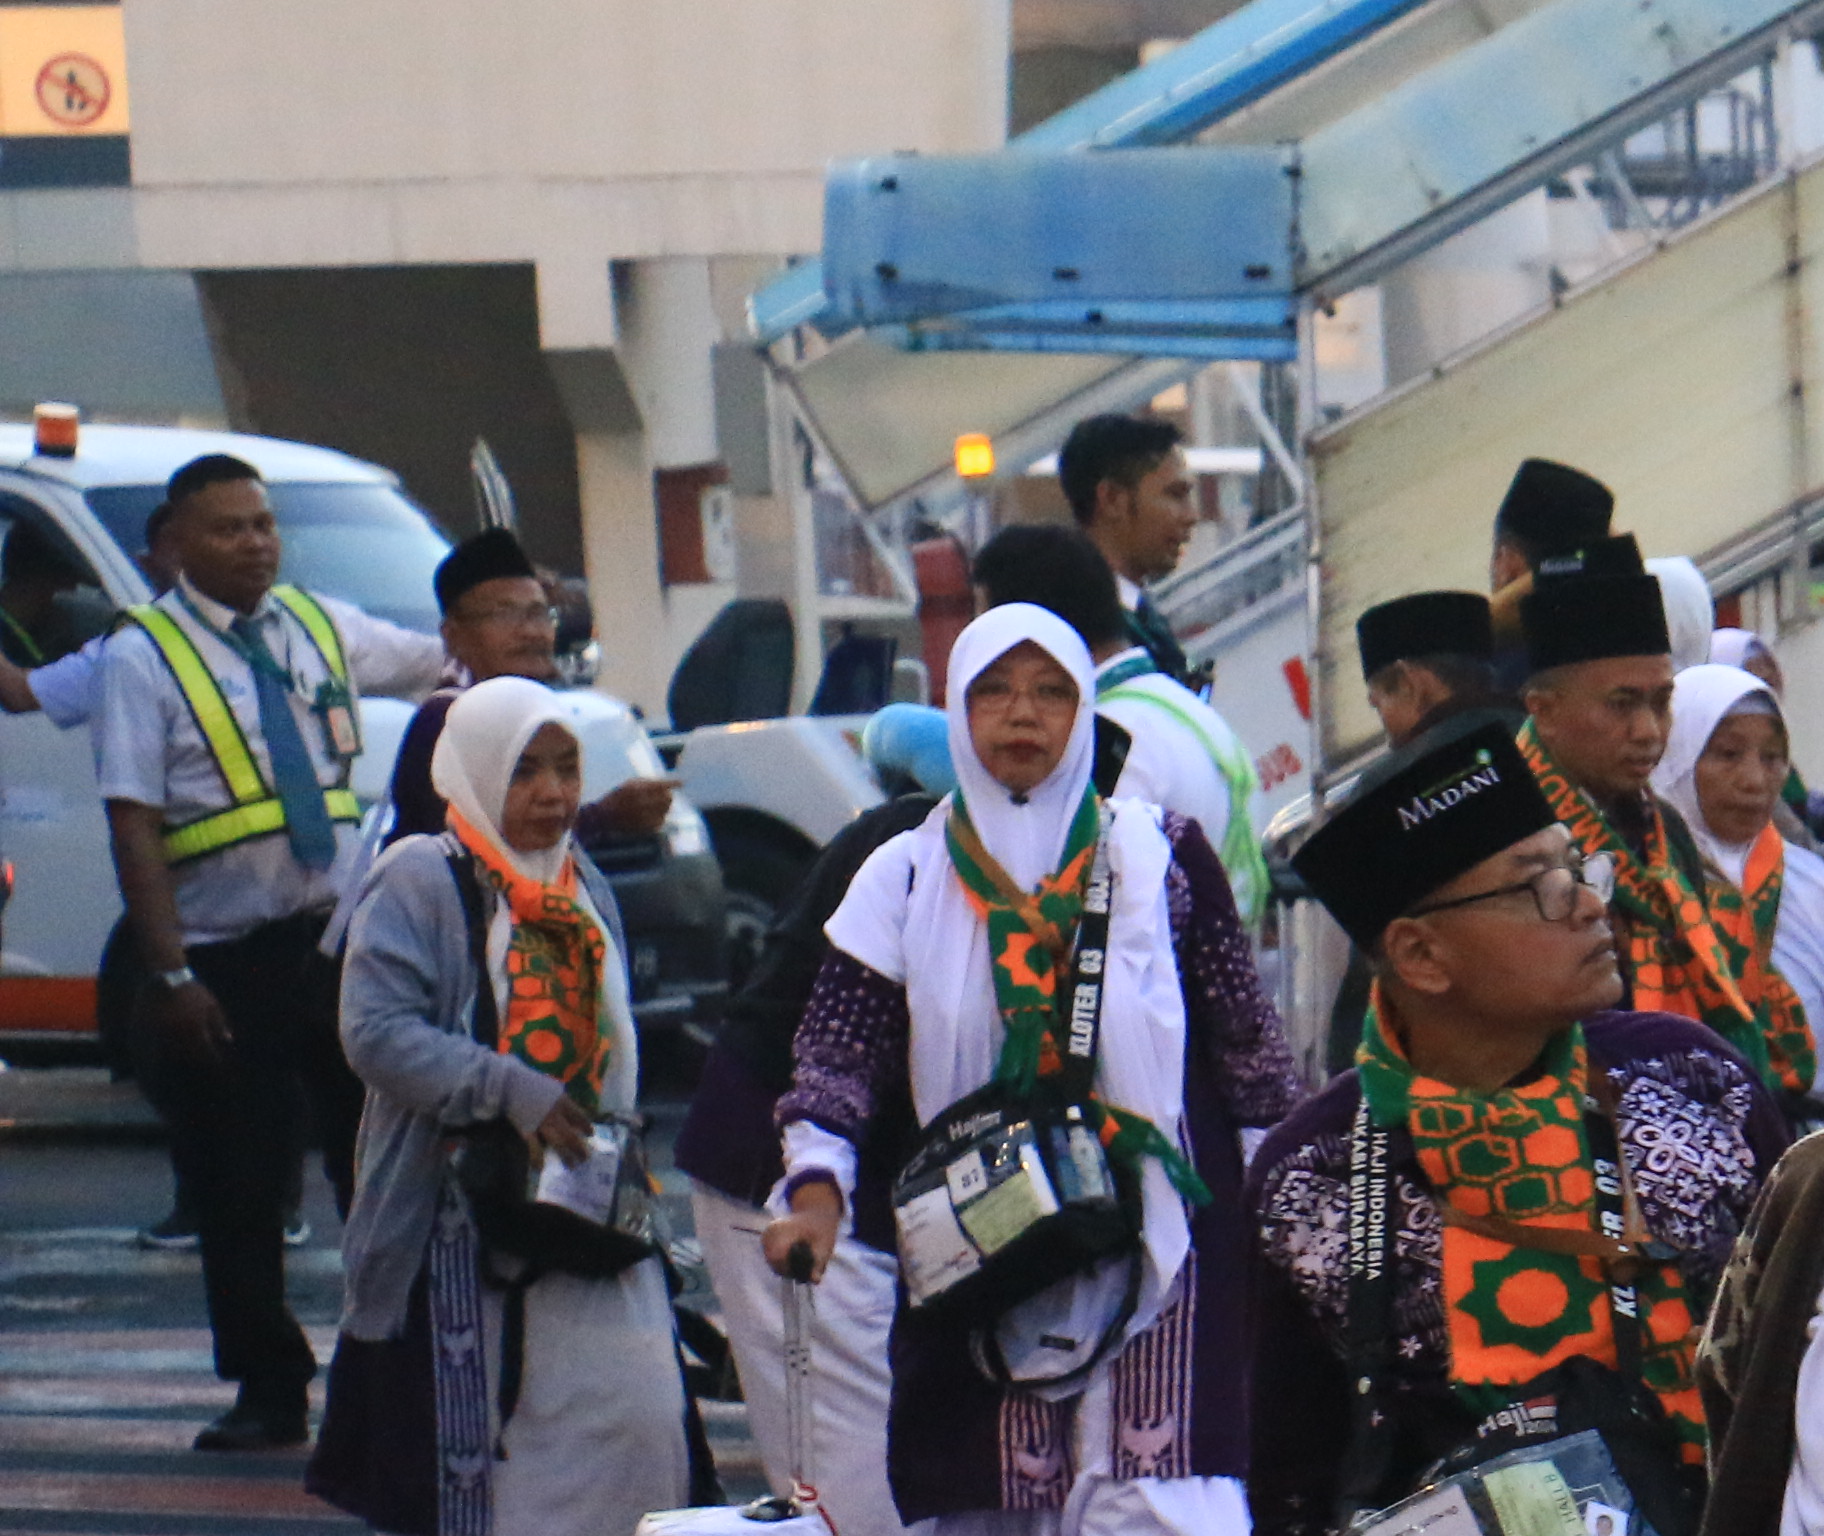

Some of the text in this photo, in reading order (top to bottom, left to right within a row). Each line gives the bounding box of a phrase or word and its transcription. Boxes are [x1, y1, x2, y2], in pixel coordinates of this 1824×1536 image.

[1397, 765, 1501, 831] MADANI
[1366, 1132, 1388, 1281] HAJI INDONESIA
